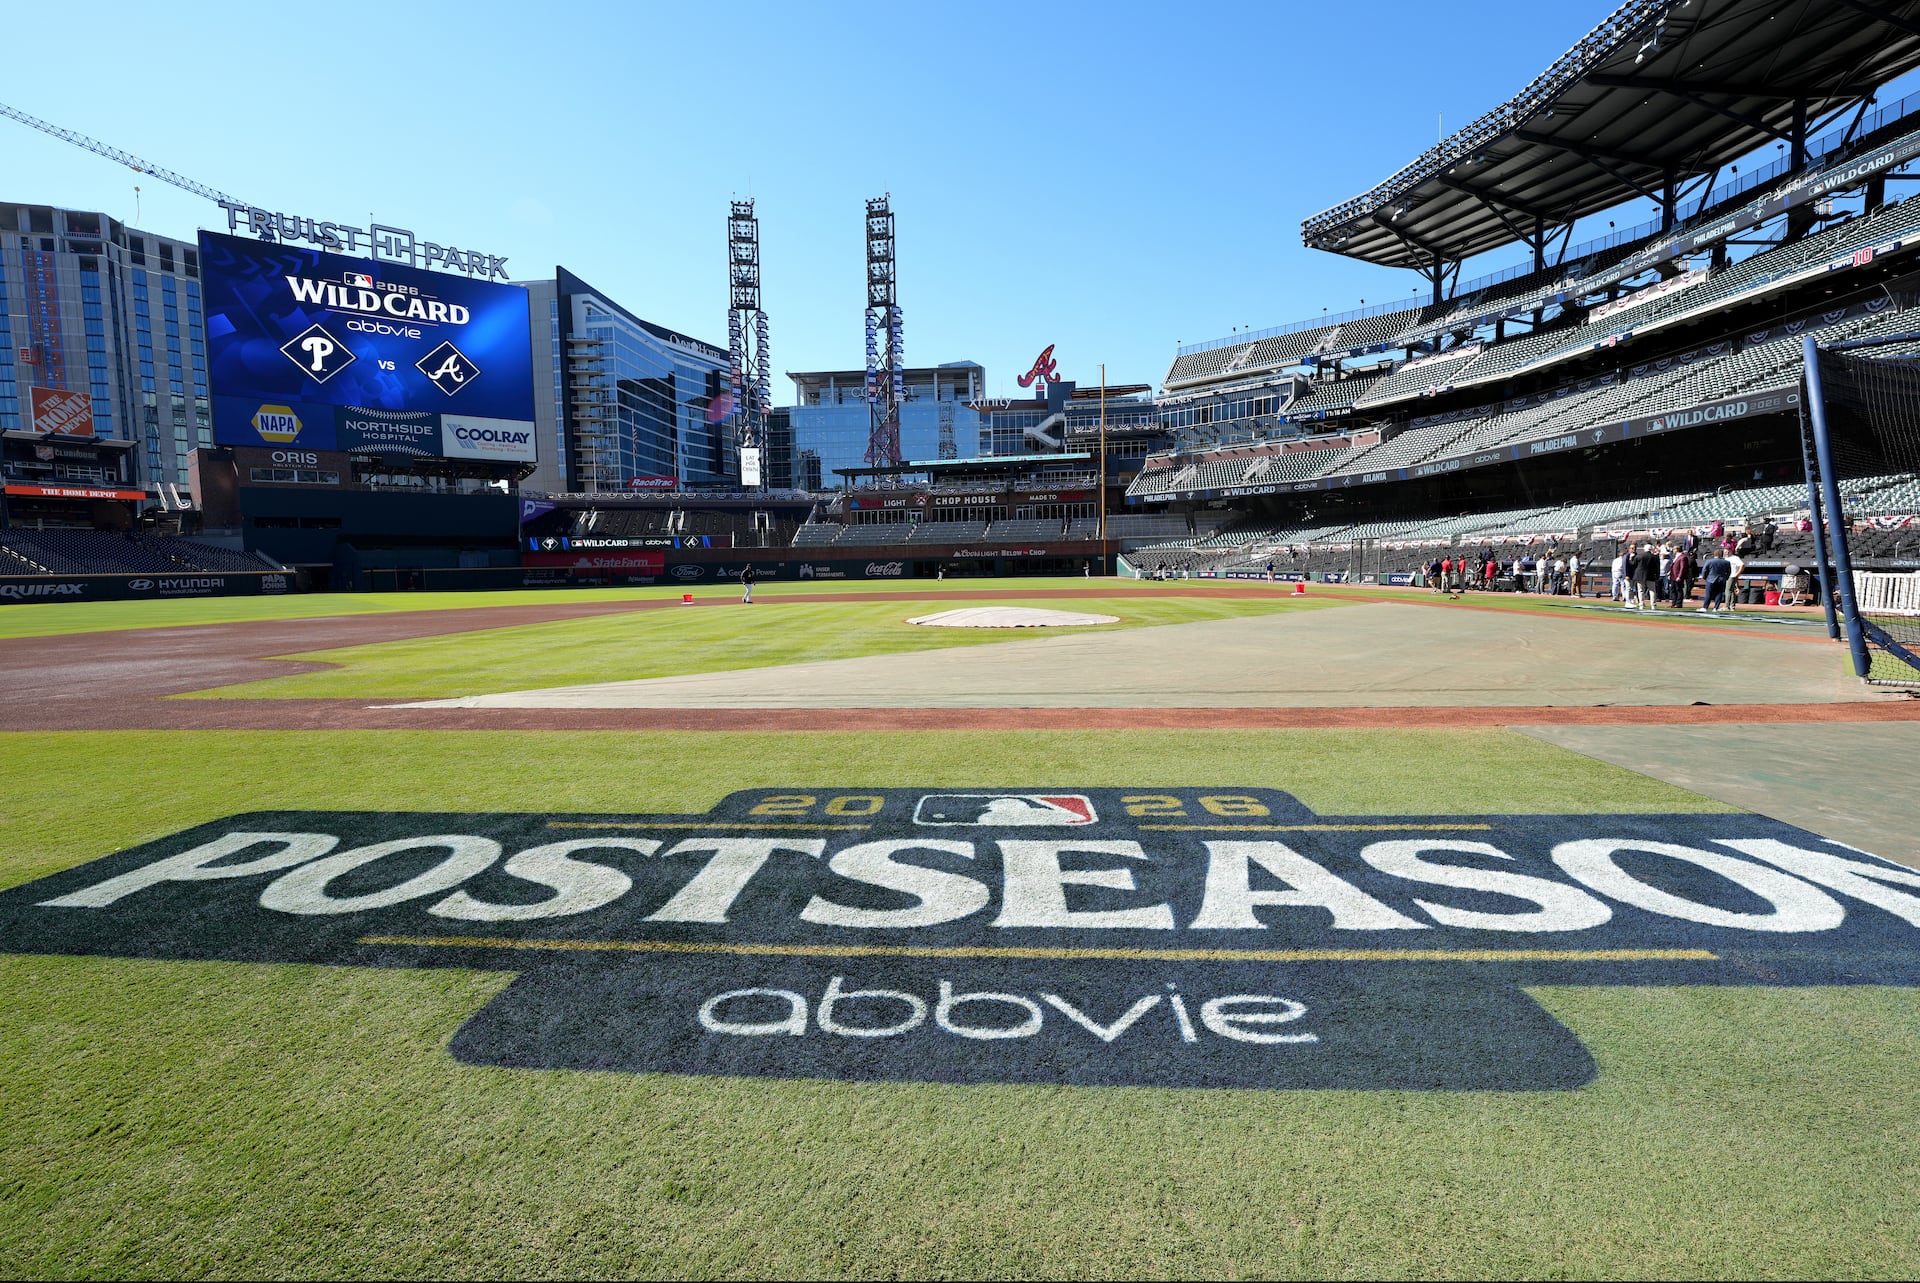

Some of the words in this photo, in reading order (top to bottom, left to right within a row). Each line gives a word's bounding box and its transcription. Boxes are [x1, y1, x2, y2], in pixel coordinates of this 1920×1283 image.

[218, 200, 362, 251] TRUIST
[424, 241, 509, 279] PARK
[1693, 221, 1735, 245] PHILADELPHIA
[1853, 248, 1872, 267] 10
[1875, 244, 1894, 256] JONES
[376, 281, 418, 296] 2026
[1520, 300, 1543, 312] ATLANTA
[347, 320, 421, 339] abbvie
[851, 386, 914, 397] COST
[39, 394, 62, 411] THE
[969, 398, 1012, 410] xfinity
[1750, 398, 1780, 410] 2026
[35, 393, 91, 433] HOME
[59, 410, 93, 434] DEPOT
[260, 415, 294, 433] NAPA
[345, 420, 433, 435] NORTHSIDE
[362, 432, 418, 442] HOSPITAL
[456, 427, 529, 444] COOLRAY
[1531, 435, 1577, 454] PHILADELPHIA
[271, 451, 318, 464] ORIS
[1475, 453, 1500, 464] abbvie
[631, 478, 674, 487] RaceTrac
[1362, 472, 1387, 483] ATLANTA
[63, 489, 88, 497] HOME
[90, 490, 118, 498] DEPOT
[935, 496, 960, 505] CHOP
[964, 495, 996, 504] HOUSE
[677, 566, 698, 576] Ford
[728, 569, 754, 577] Geoa
[865, 562, 904, 576] Coca-Cola
[159, 578, 224, 588] HYUNDAI
[262, 575, 286, 583] PAPA
[0, 584, 83, 598] QUIFAX
[750, 794, 885, 816] 20
[1121, 794, 1271, 816] 26
[697, 976, 1319, 1044] abbvie
